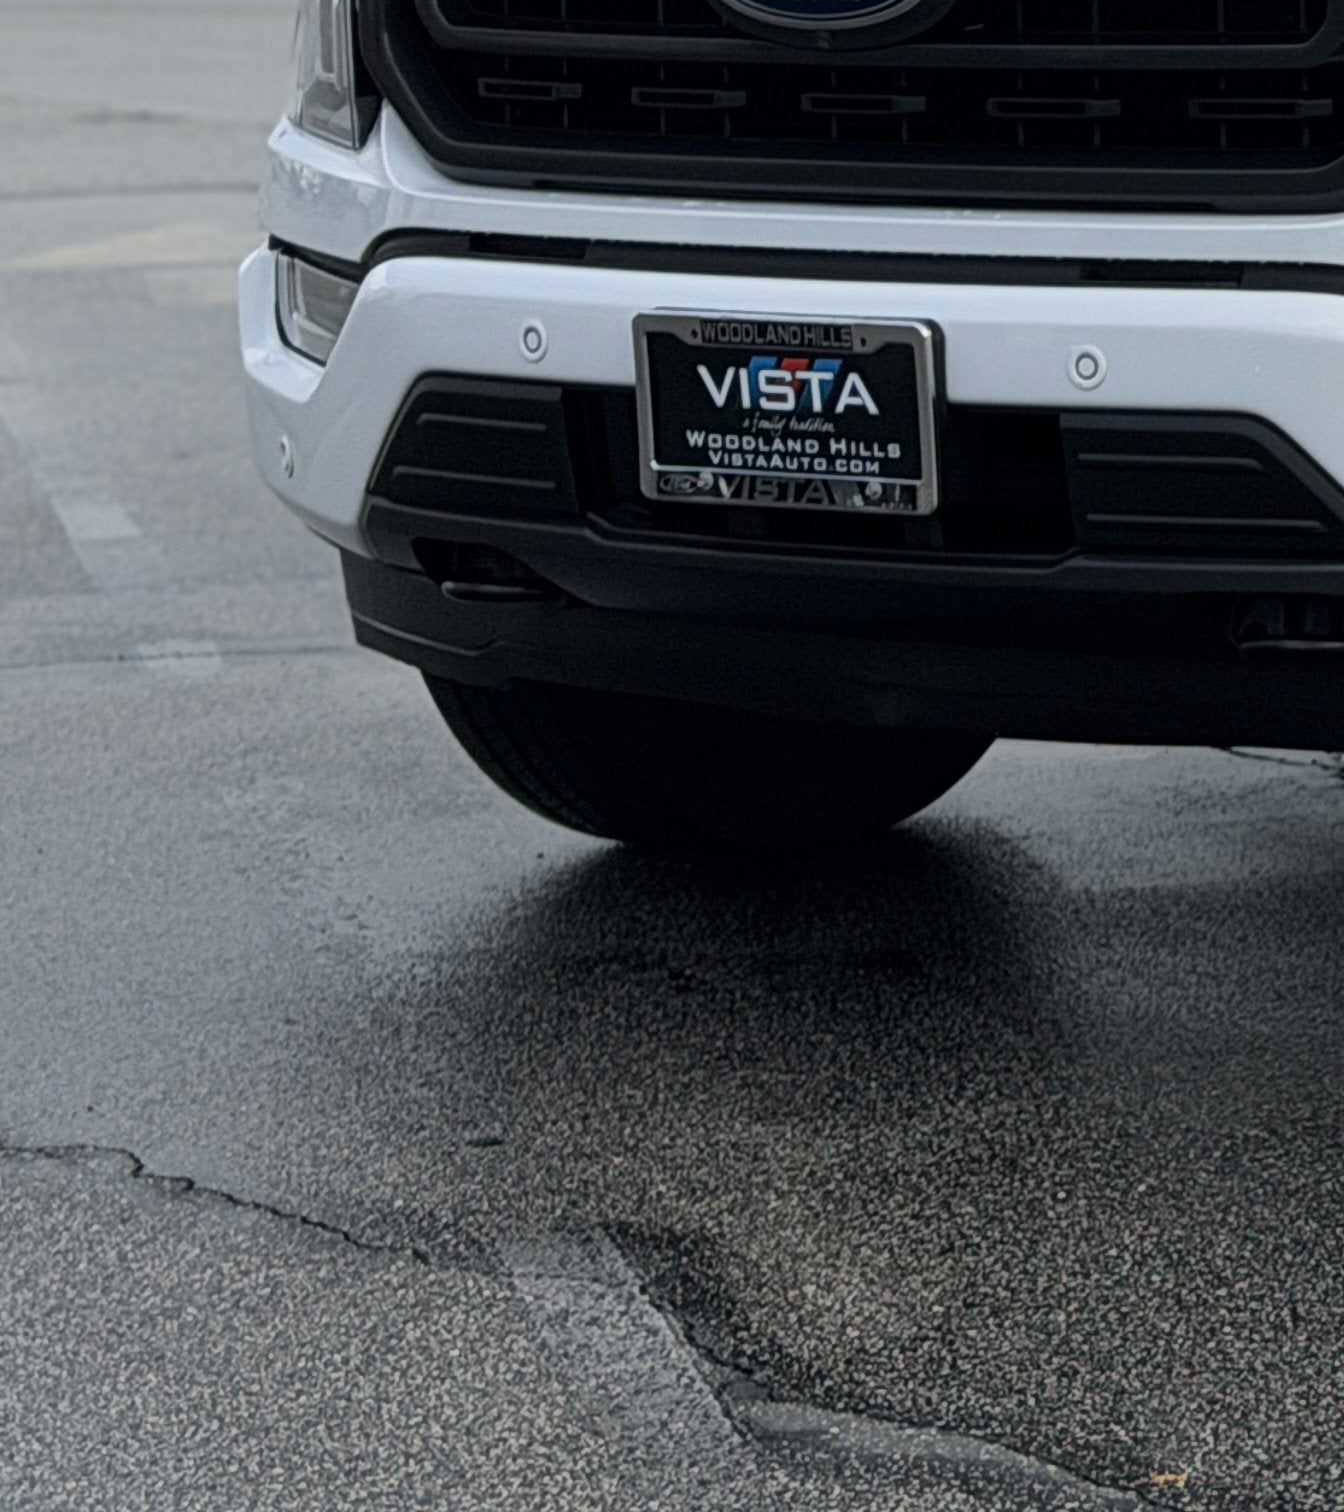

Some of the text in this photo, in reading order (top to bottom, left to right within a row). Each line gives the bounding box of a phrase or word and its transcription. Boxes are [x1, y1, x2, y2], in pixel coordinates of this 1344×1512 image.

[702, 322, 852, 348] WOODLAND HILLS
[697, 364, 879, 416] VISTA
[686, 429, 901, 459] WOODLAND HILLS
[718, 475, 832, 506] VISTA
